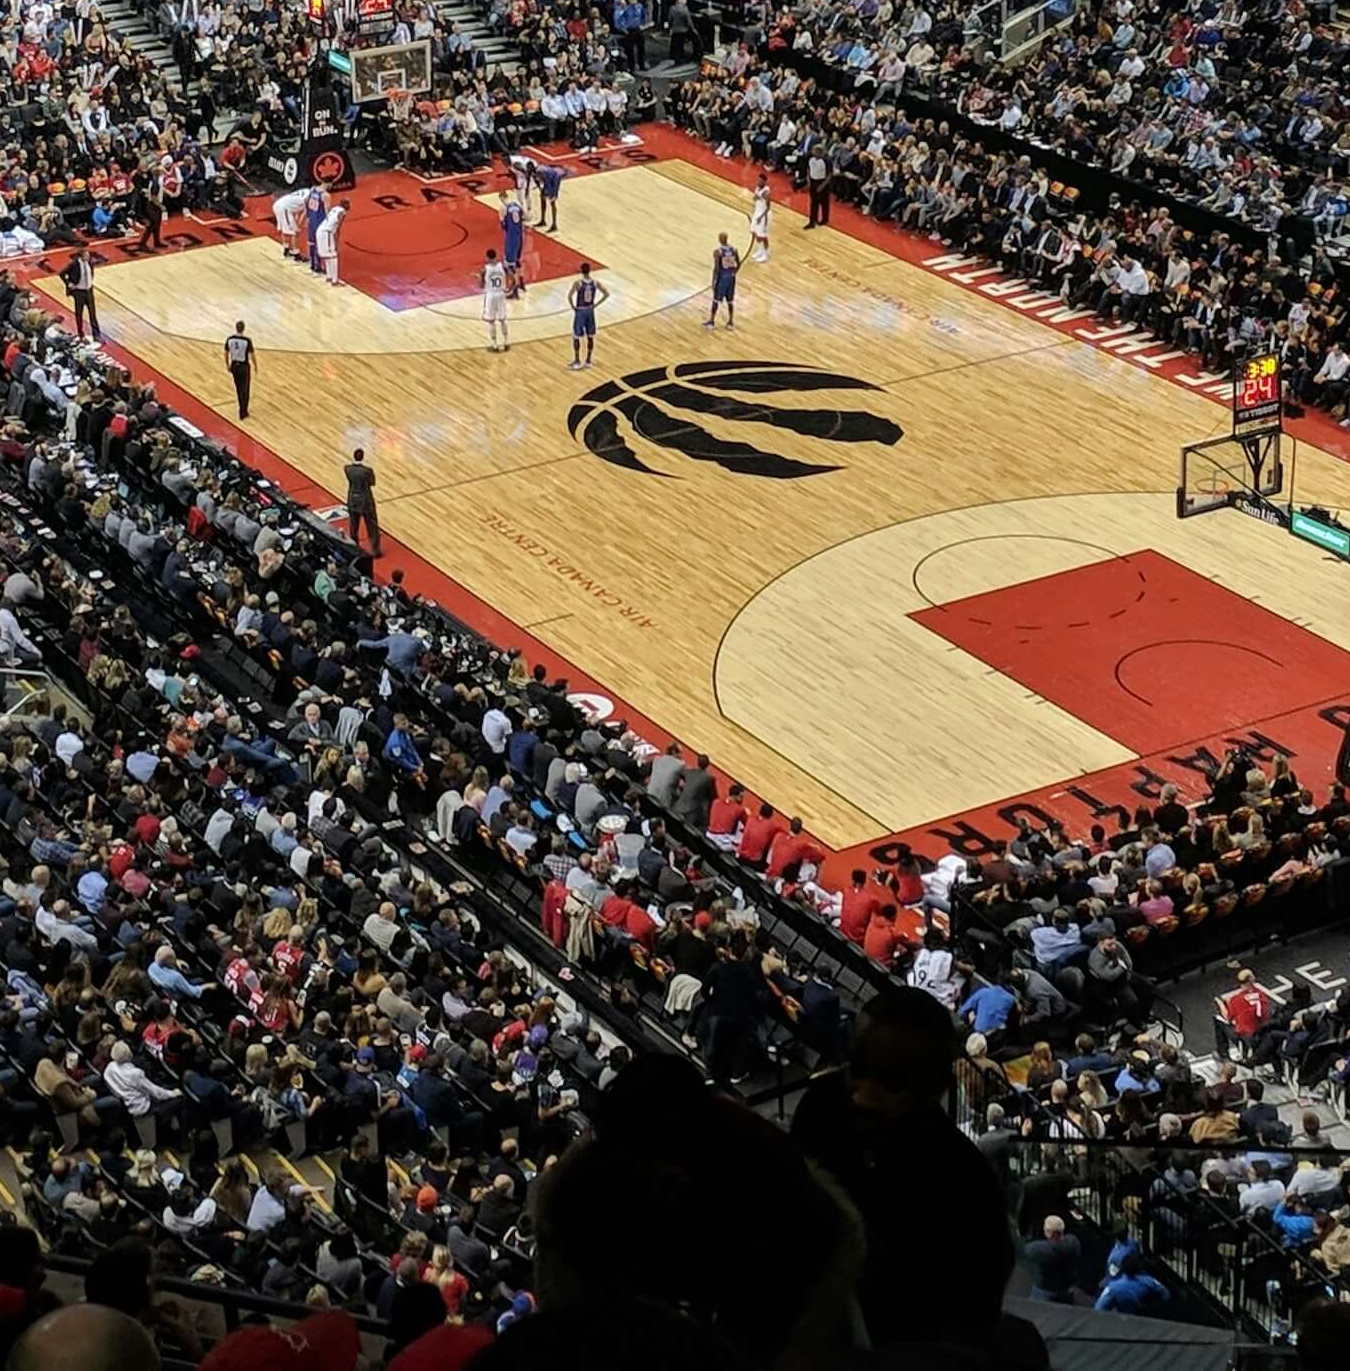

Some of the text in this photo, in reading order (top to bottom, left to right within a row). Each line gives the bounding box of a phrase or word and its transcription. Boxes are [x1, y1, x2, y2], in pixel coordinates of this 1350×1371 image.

[490, 277, 502, 288] 10
[922, 252, 1186, 368] THE NORTH
[1248, 357, 1277, 378] 3:38
[1244, 377, 1273, 406] 24
[1242, 501, 1280, 525] Sun Life
[479, 514, 660, 629] AIR CANADA CENTRE
